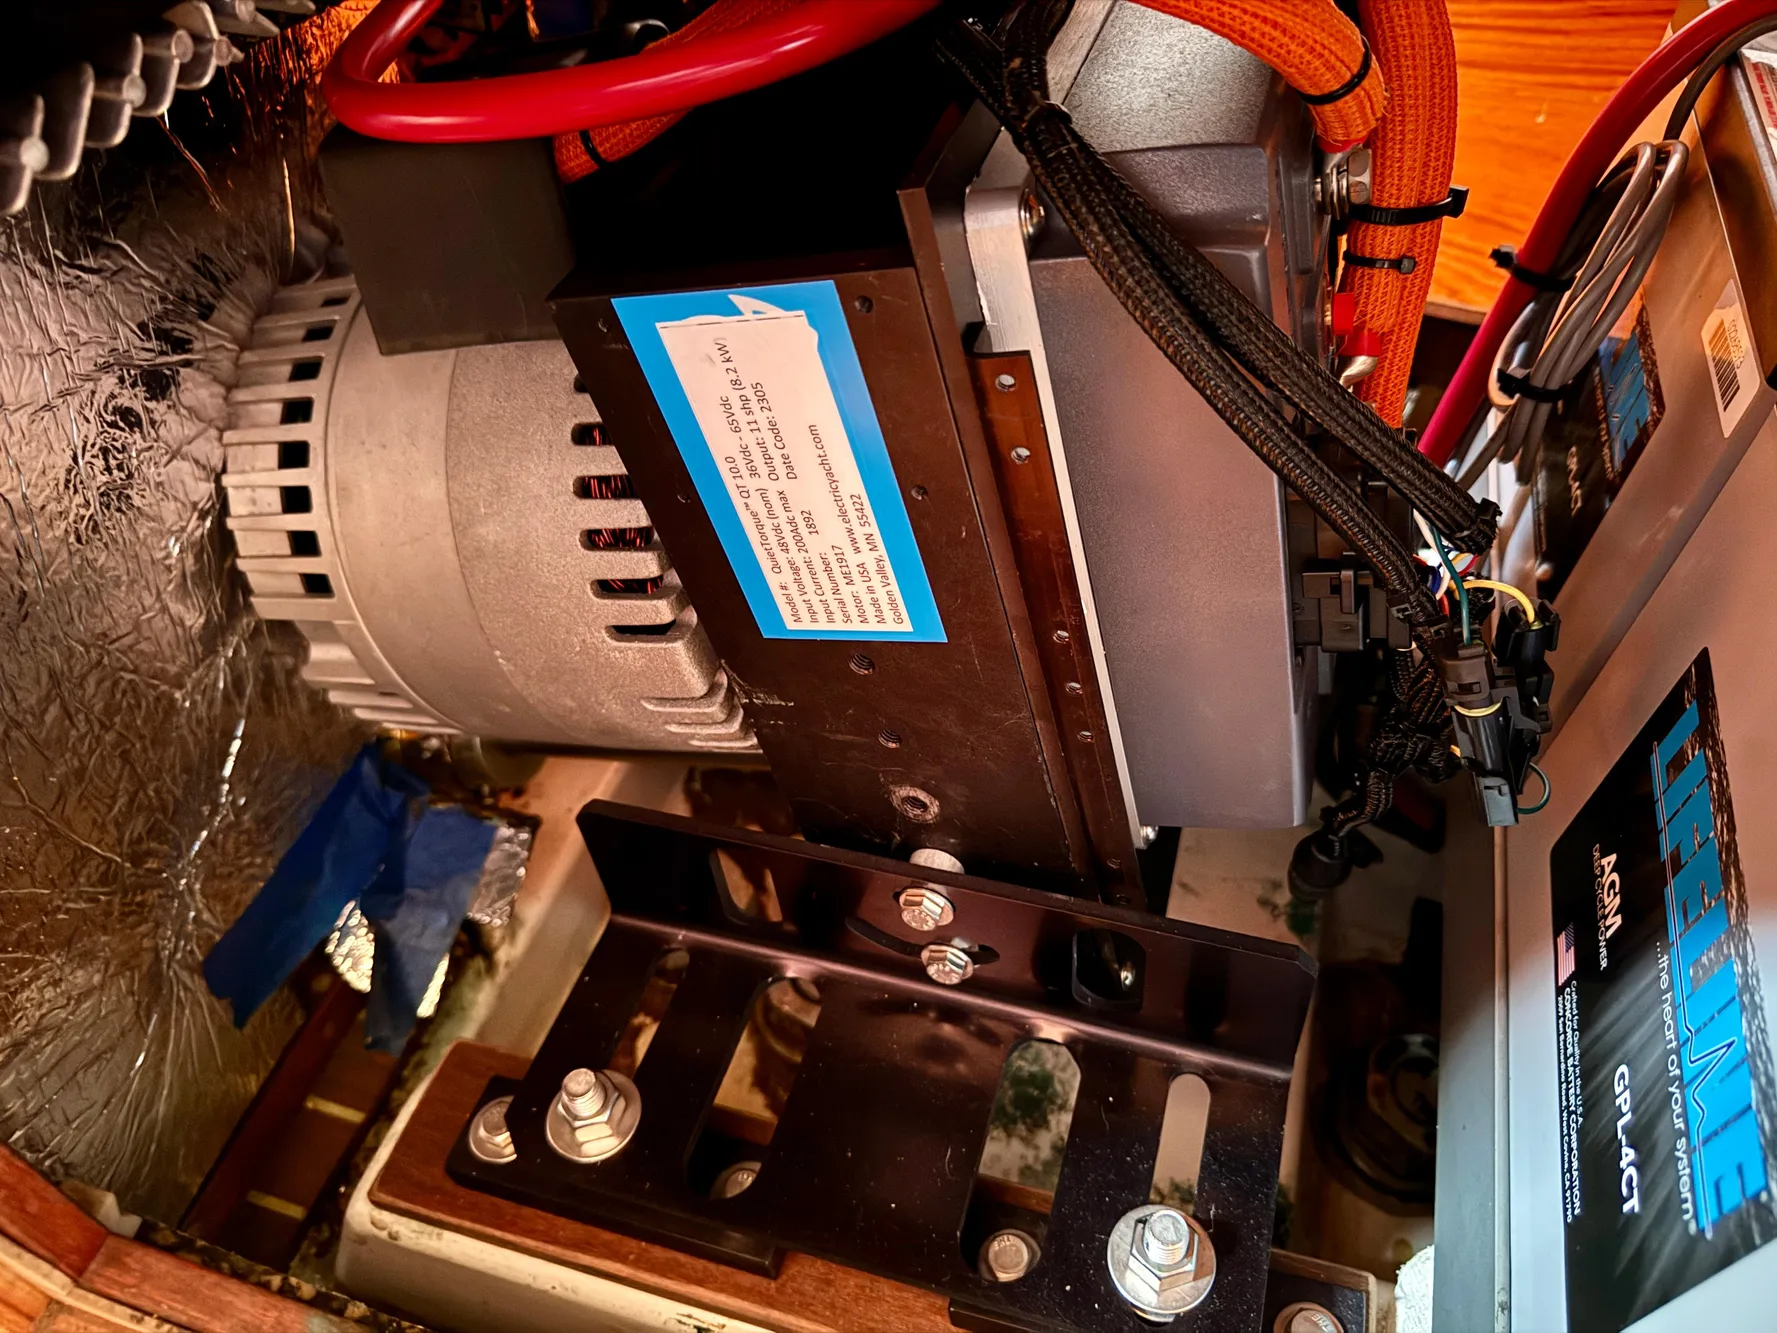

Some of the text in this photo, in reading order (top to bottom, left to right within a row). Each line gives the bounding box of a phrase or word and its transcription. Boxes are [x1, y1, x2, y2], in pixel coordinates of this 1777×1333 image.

[726, 367, 746, 390] (8.2
[720, 396, 742, 433] 65Vdc
[739, 395, 754, 416] shp
[747, 420, 761, 433] 11
[725, 456, 744, 480] 10.0
[739, 444, 761, 479] 36Vdc
[756, 438, 780, 481] Output:
[736, 484, 750, 499] QT
[751, 382, 853, 624] Serial Number: 1892 Date Code: 2305
[755, 488, 779, 520] (nom)
[776, 490, 792, 512] max
[770, 522, 791, 554] 48Vdc
[786, 516, 809, 553] 200Adc
[807, 424, 887, 624] Made in USA www.electricyacht.com
[786, 557, 808, 596] Voltage:
[803, 556, 825, 596] Current:
[850, 494, 904, 624] Golden Valley, MN 55422
[779, 582, 789, 591] #:
[832, 545, 869, 624] Motor: ME1917
[782, 593, 803, 623] Model
[802, 599, 819, 623] Input
[819, 599, 836, 623] Input
[1593, 844, 1608, 970] DEEP CYCLE POWER
[1601, 853, 1622, 939] AGM
[1649, 700, 1768, 1232] LIFELINE
[1659, 992, 1677, 1051] heart
[1667, 1054, 1681, 1076] of
[1564, 988, 1581, 1215] CONCORDE BATTERY CORPORATION
[1668, 1079, 1686, 1132] your
[1612, 1064, 1640, 1214] GPL-4CT
[1565, 1172, 1570, 1190] CA
